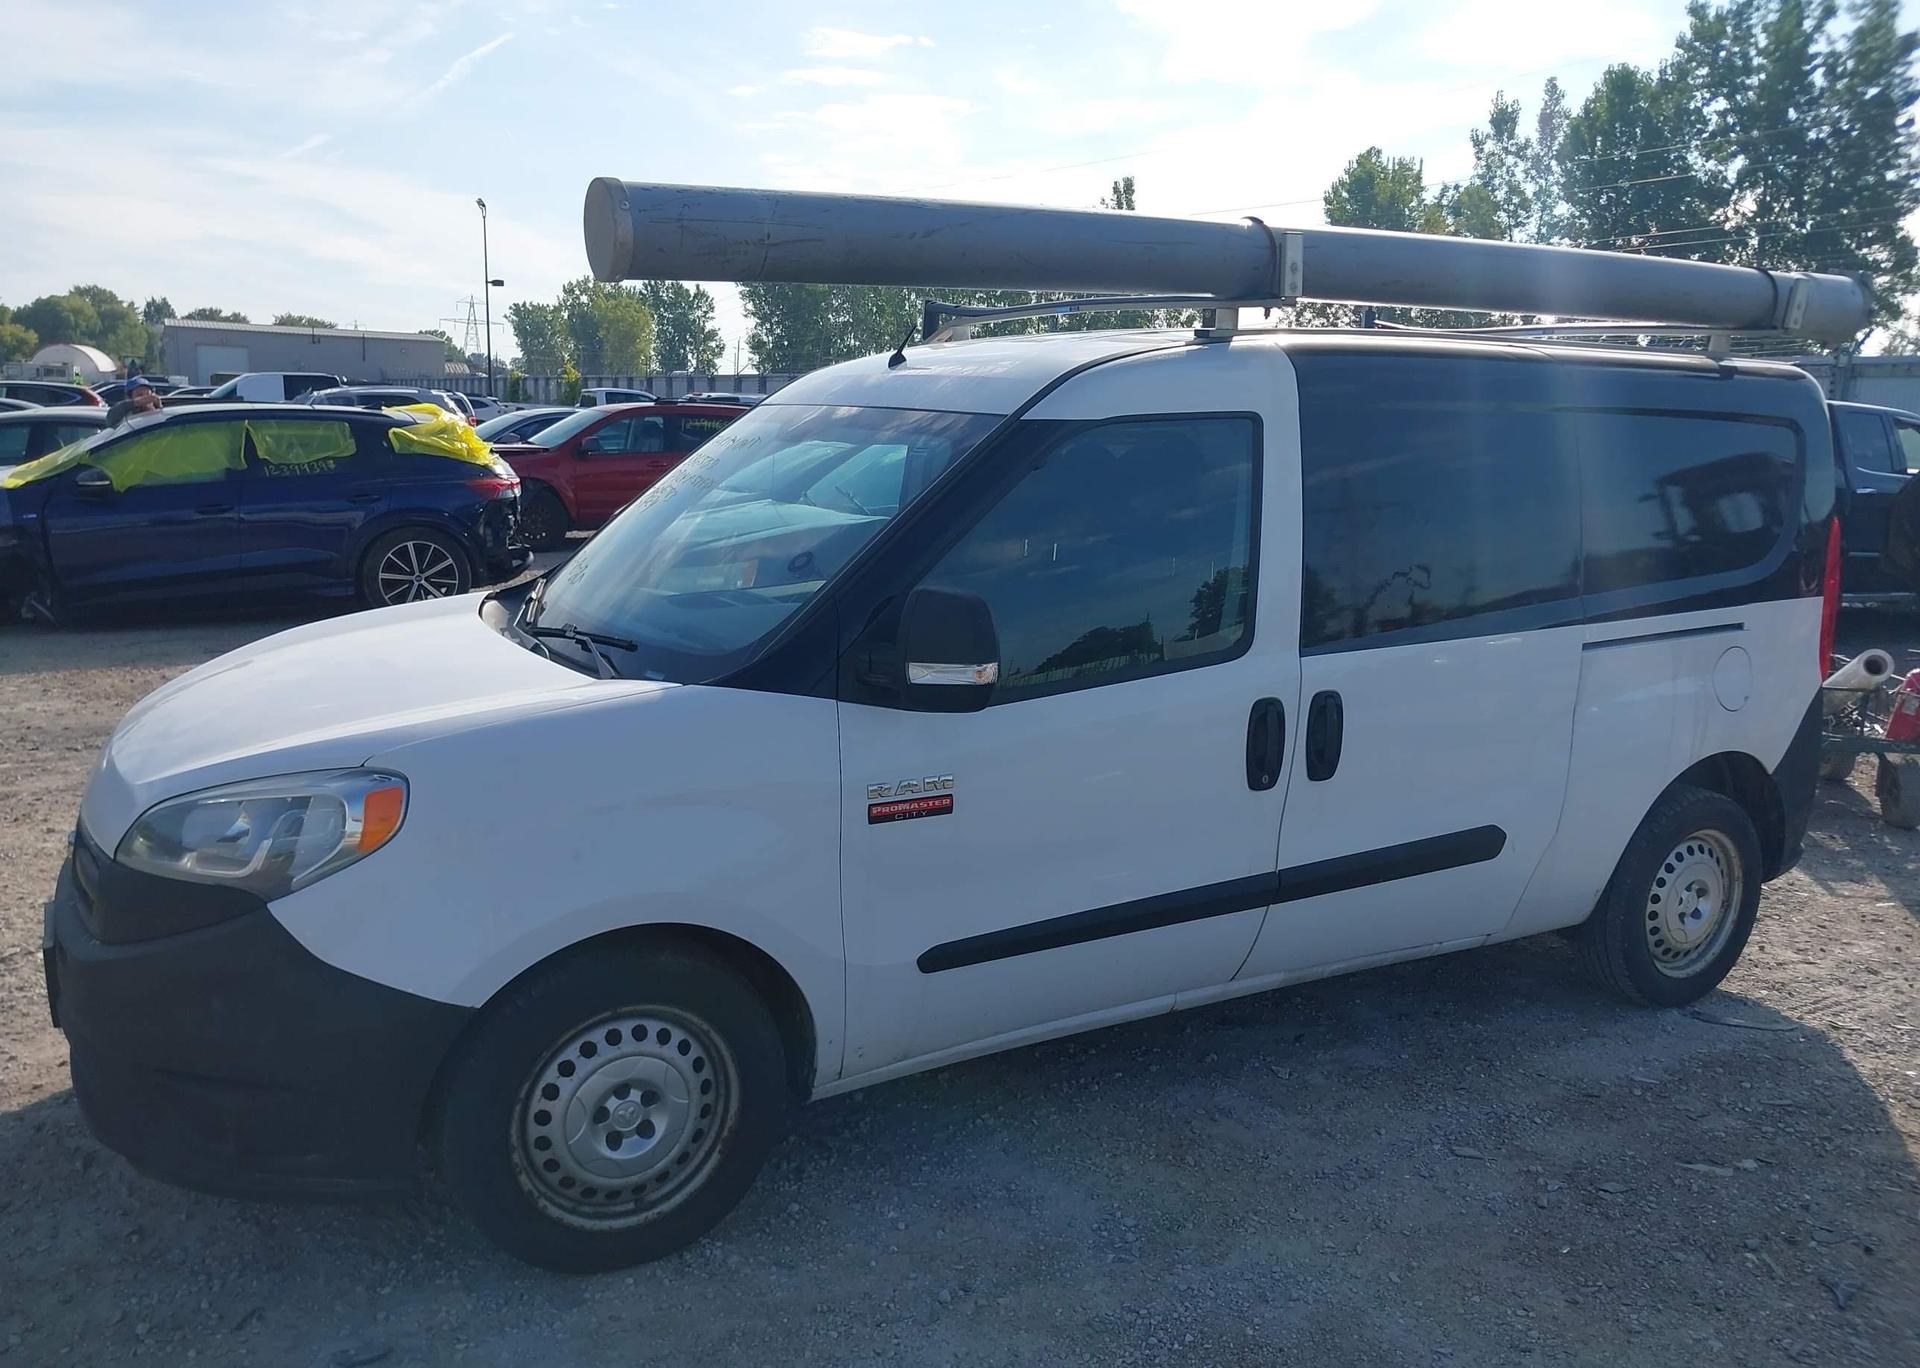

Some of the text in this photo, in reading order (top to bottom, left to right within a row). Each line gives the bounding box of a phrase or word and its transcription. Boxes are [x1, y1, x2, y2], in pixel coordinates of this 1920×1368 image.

[867, 774, 954, 799] RAM
[872, 799, 950, 813] PROMASTER
[895, 810, 928, 820] CITY
